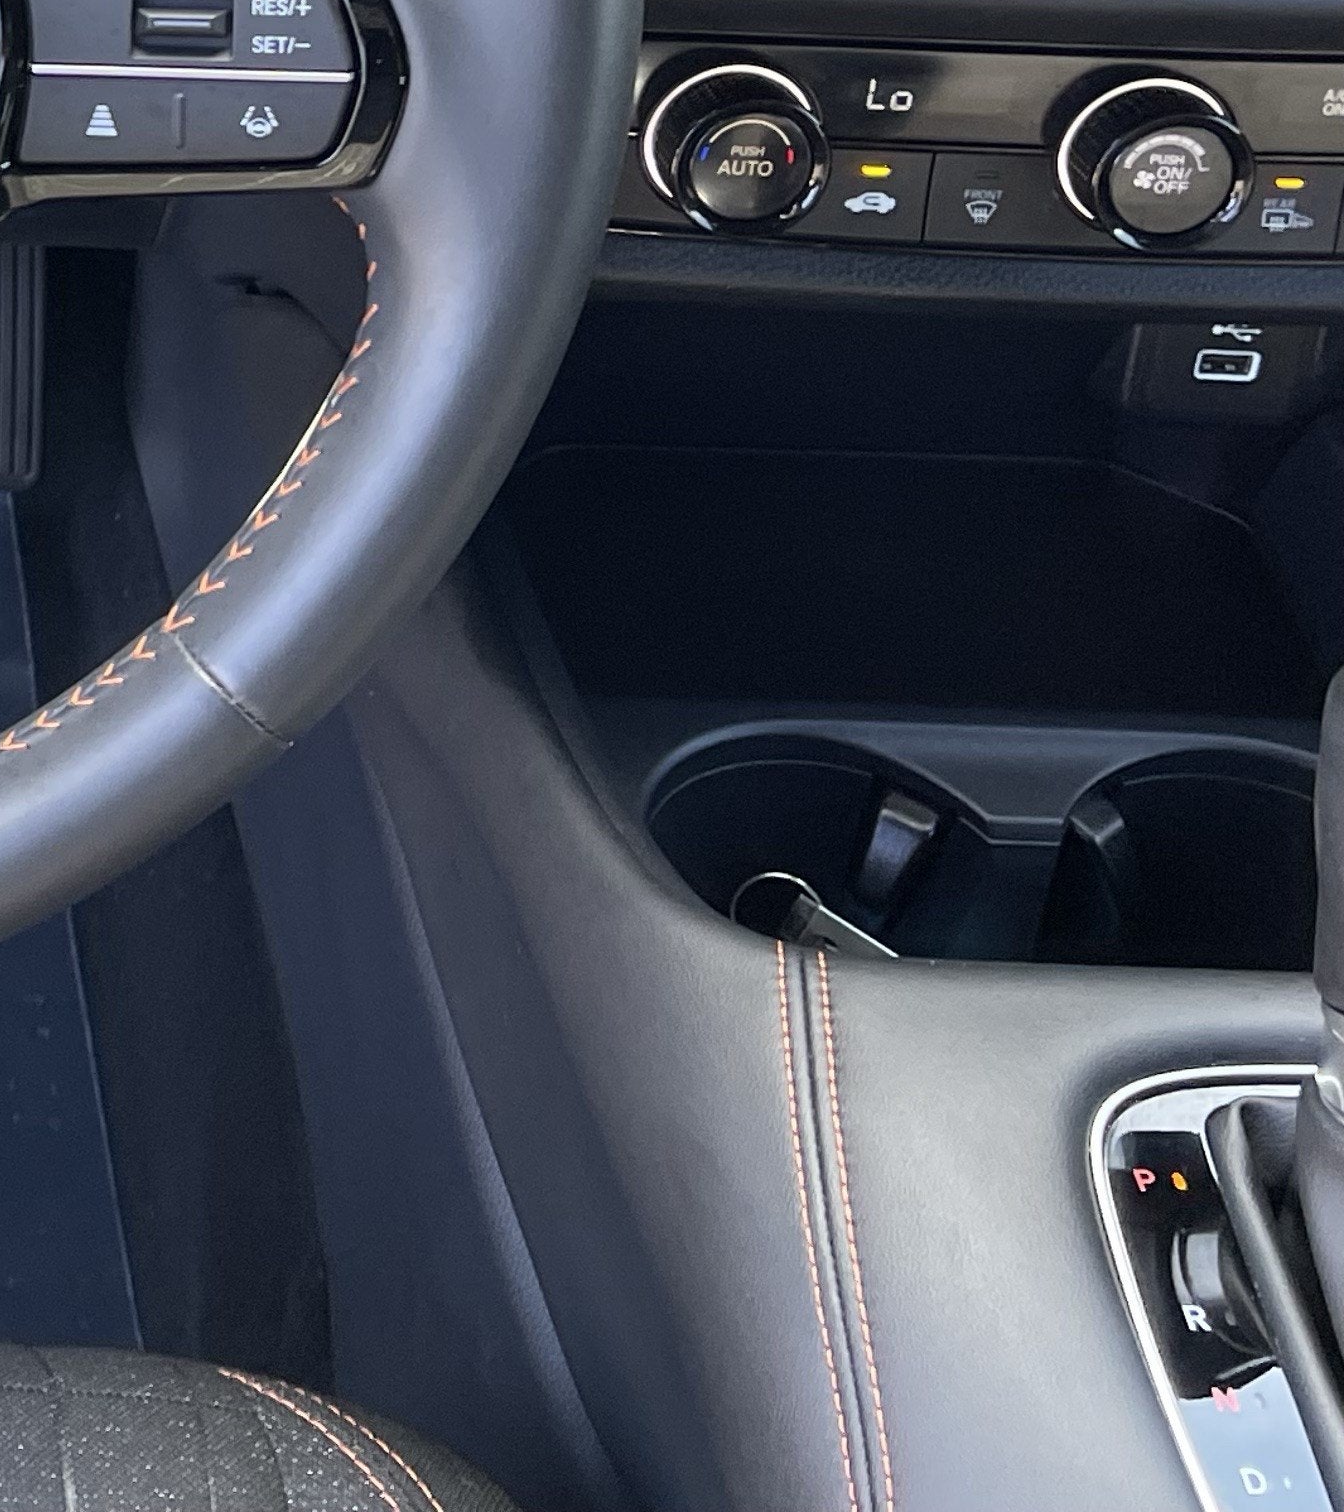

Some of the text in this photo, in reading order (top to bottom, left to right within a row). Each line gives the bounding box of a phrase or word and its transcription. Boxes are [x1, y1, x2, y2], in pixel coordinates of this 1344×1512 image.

[730, 144, 767, 157] PUSH
[1149, 153, 1187, 166] PUSH
[715, 159, 775, 178] AUTO
[963, 189, 1004, 201] FRONT
[1152, 179, 1191, 196] OFF
[1131, 1167, 1157, 1193] P
[1180, 1303, 1213, 1333] R
[1210, 1384, 1242, 1413] N
[1239, 1465, 1270, 1496] D
